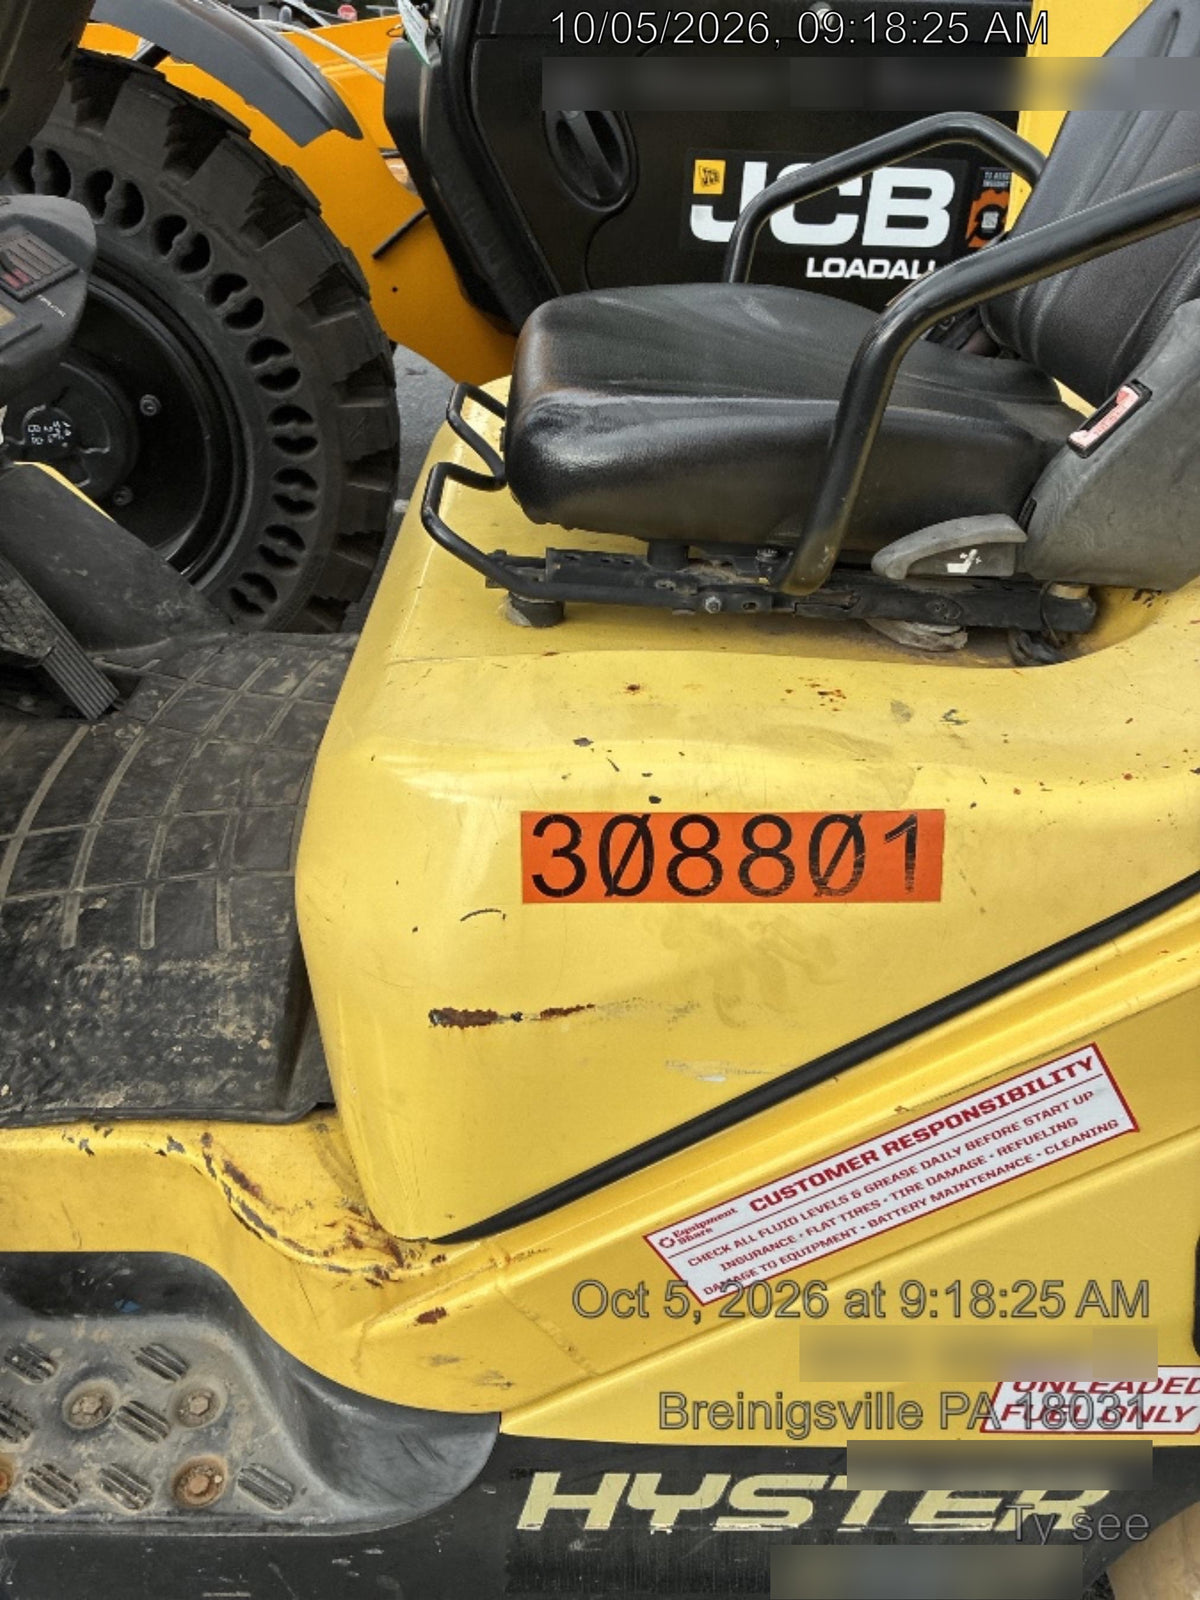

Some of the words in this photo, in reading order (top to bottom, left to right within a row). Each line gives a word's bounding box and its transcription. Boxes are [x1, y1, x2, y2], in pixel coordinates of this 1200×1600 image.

[690, 161, 955, 248] JCB
[531, 813, 918, 897] 308801
[746, 1148, 881, 1213] CUSTOMER
[880, 1055, 1097, 1156] RESPONSIBILITY
[686, 1243, 733, 1267] CHECK
[731, 1233, 758, 1248] ALL
[756, 1215, 799, 1238] FLUID
[798, 1194, 850, 1220] LEVELS
[862, 1165, 919, 1194] GREASE
[919, 1146, 964, 1170] DAILY
[963, 1121, 1022, 1152] BEFORE
[1022, 1100, 1071, 1127] START
[1071, 1090, 1096, 1107] UP
[718, 1234, 798, 1271] INSURANCE
[803, 1217, 839, 1236] FLAT
[837, 1199, 883, 1222] TIRES
[889, 1181, 925, 1201] TIRE
[924, 1154, 988, 1186] DAMAGE
[995, 1116, 1080, 1157] REFUELING
[758, 1259, 779, 1272] TO
[777, 1226, 860, 1264] EQUIPMENT
[866, 1197, 929, 1228] BATTERY
[928, 1154, 1035, 1203] MAINTENANCE
[1042, 1118, 1120, 1156] CLEANING
[671, 1206, 739, 1239] Equipment
[1101, 1404, 1197, 1423] ONLY
[516, 1472, 1111, 1532] HYSTER
